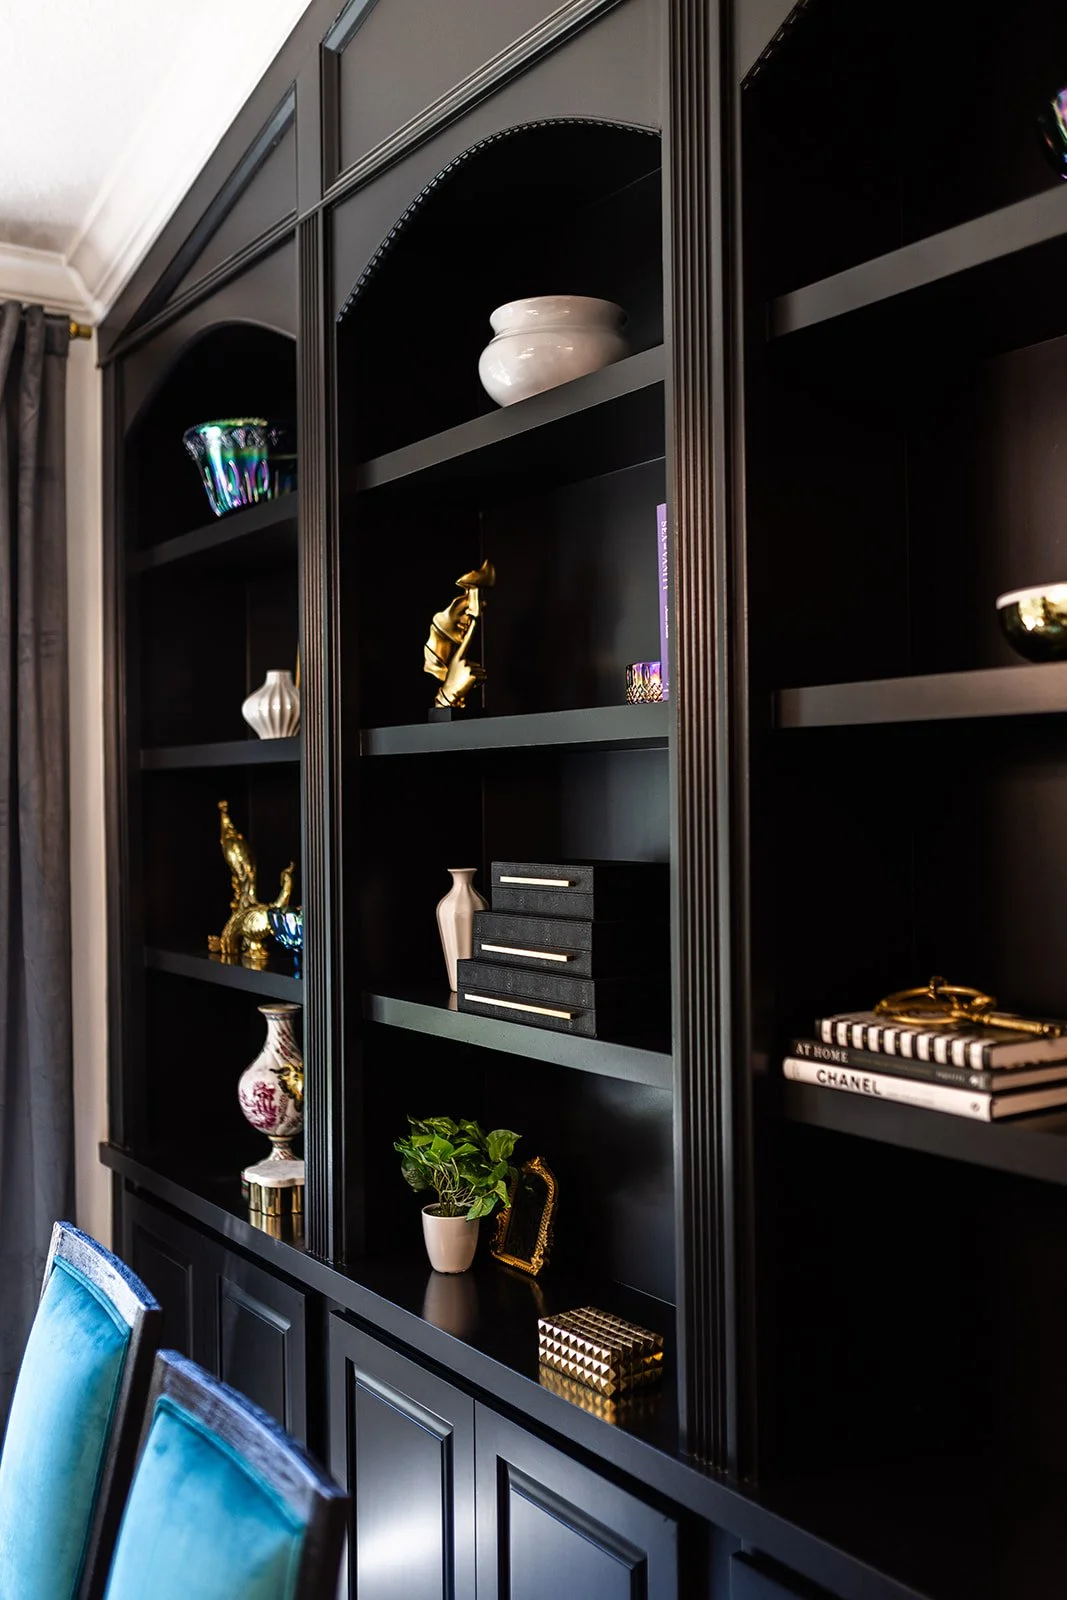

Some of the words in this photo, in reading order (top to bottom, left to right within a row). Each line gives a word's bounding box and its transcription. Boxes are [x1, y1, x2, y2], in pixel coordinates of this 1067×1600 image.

[796, 1043, 811, 1056] AT
[813, 1046, 849, 1063] HOME
[816, 1069, 882, 1096] CHANEL
